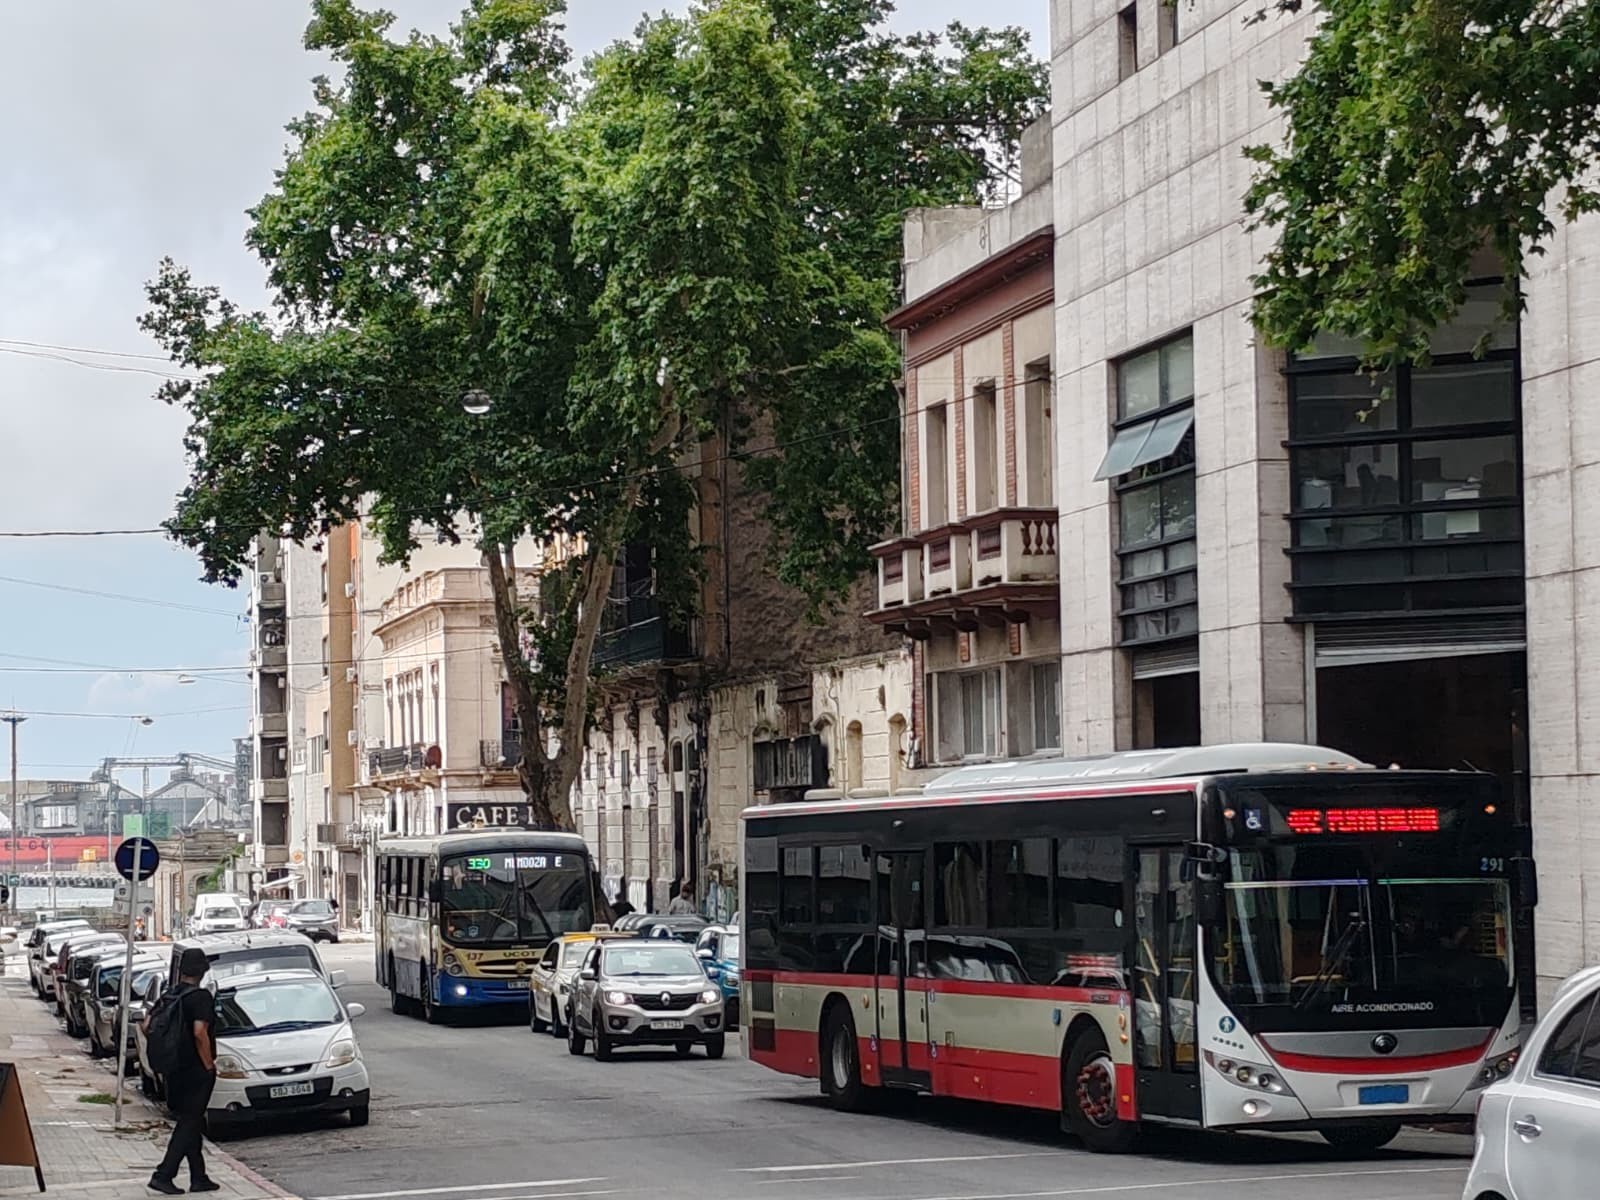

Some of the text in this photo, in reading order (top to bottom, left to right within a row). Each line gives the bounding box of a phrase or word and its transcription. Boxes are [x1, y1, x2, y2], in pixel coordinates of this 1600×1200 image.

[456, 806, 519, 826] CAFE
[467, 858, 491, 870] 330
[1480, 857, 1504, 872] 291
[466, 952, 484, 961] 137
[1331, 1001, 1434, 1013] AIRE ACONDICIONADO
